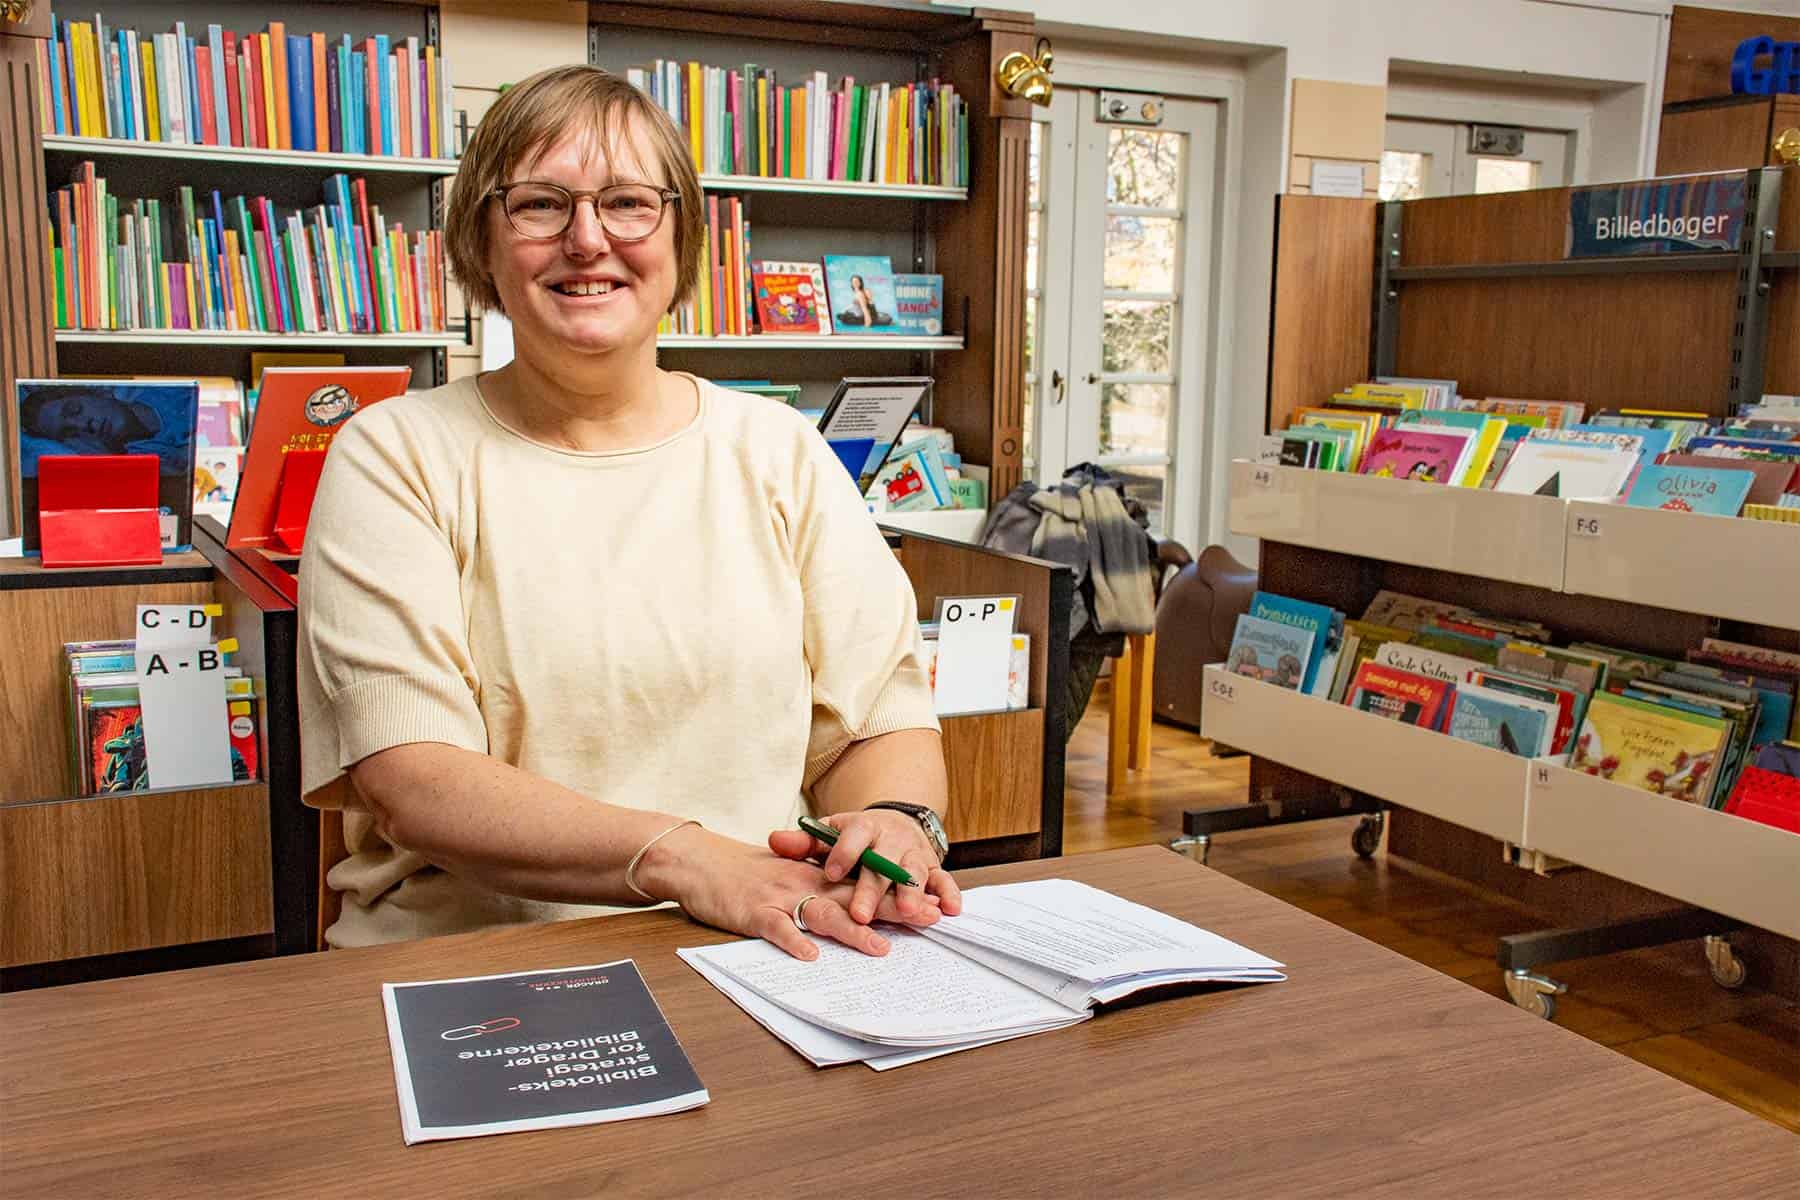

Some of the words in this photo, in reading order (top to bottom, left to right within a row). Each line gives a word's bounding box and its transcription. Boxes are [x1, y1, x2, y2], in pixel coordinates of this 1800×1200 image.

[1595, 213, 1729, 240] Billedbøger
[1656, 474, 1719, 496] Olivia
[1577, 518, 1599, 534] F-G
[141, 609, 161, 629] C
[188, 609, 208, 629] D
[946, 604, 963, 622] O
[982, 603, 996, 621] P
[145, 653, 169, 676] A
[198, 650, 219, 671] B
[1538, 768, 1548, 783] H
[457, 1031, 640, 1060] Bibliotekerne
[608, 1041, 647, 1055] for
[504, 1049, 600, 1068] Dragør
[546, 1054, 652, 1078] strategi
[508, 1064, 659, 1093] Biblioteks-
